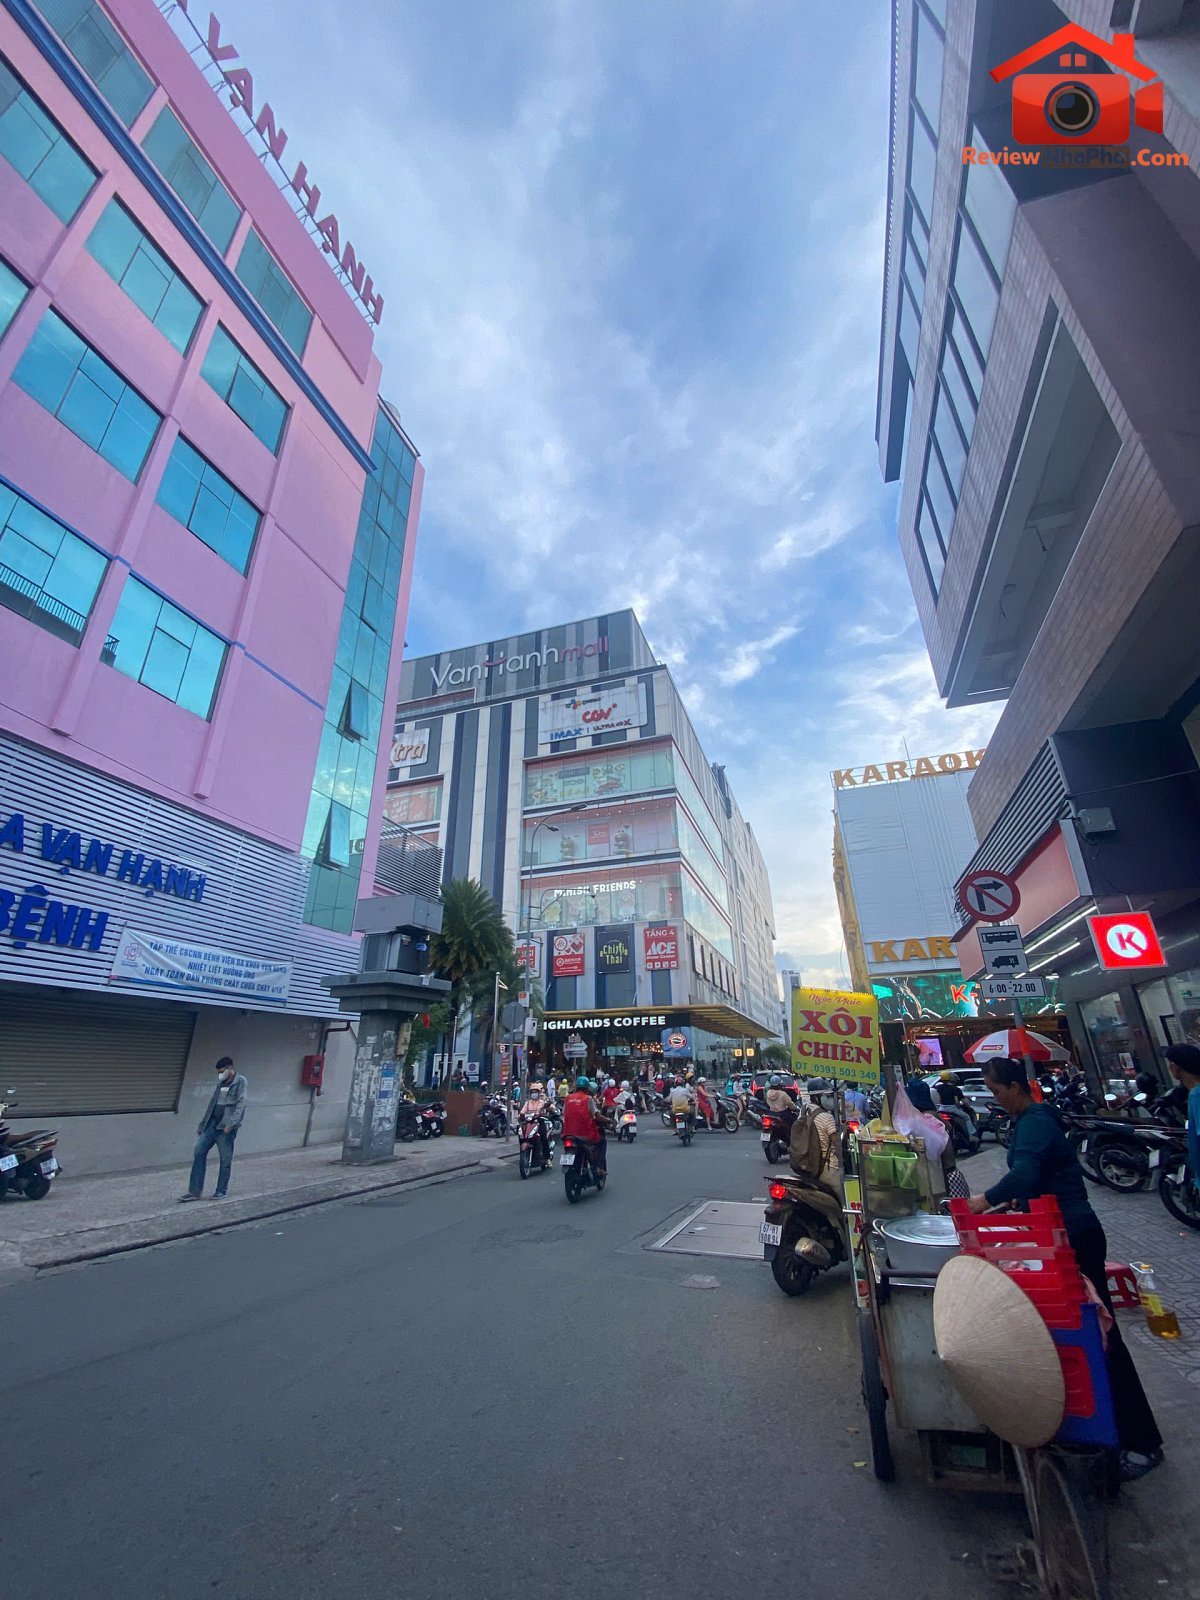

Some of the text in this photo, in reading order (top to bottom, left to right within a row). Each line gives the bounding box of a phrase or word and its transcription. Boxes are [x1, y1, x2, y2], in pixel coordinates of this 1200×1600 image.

[208, 12, 384, 325] VẠN HẠNH
[582, 707, 612, 723] CGV
[550, 727, 583, 740] IMAX
[41, 823, 114, 876] VẠN
[117, 849, 207, 901] HẠNH
[593, 880, 637, 894] FRIENDS
[646, 940, 676, 956] ACE
[606, 954, 623, 965] Thai
[543, 1015, 666, 1030] IGHLANDS COFFEE
[800, 1007, 873, 1039] XÔI
[797, 1040, 873, 1065] CHIÊN
[839, 1067, 857, 1078] 503
[859, 1070, 877, 1081] 349
